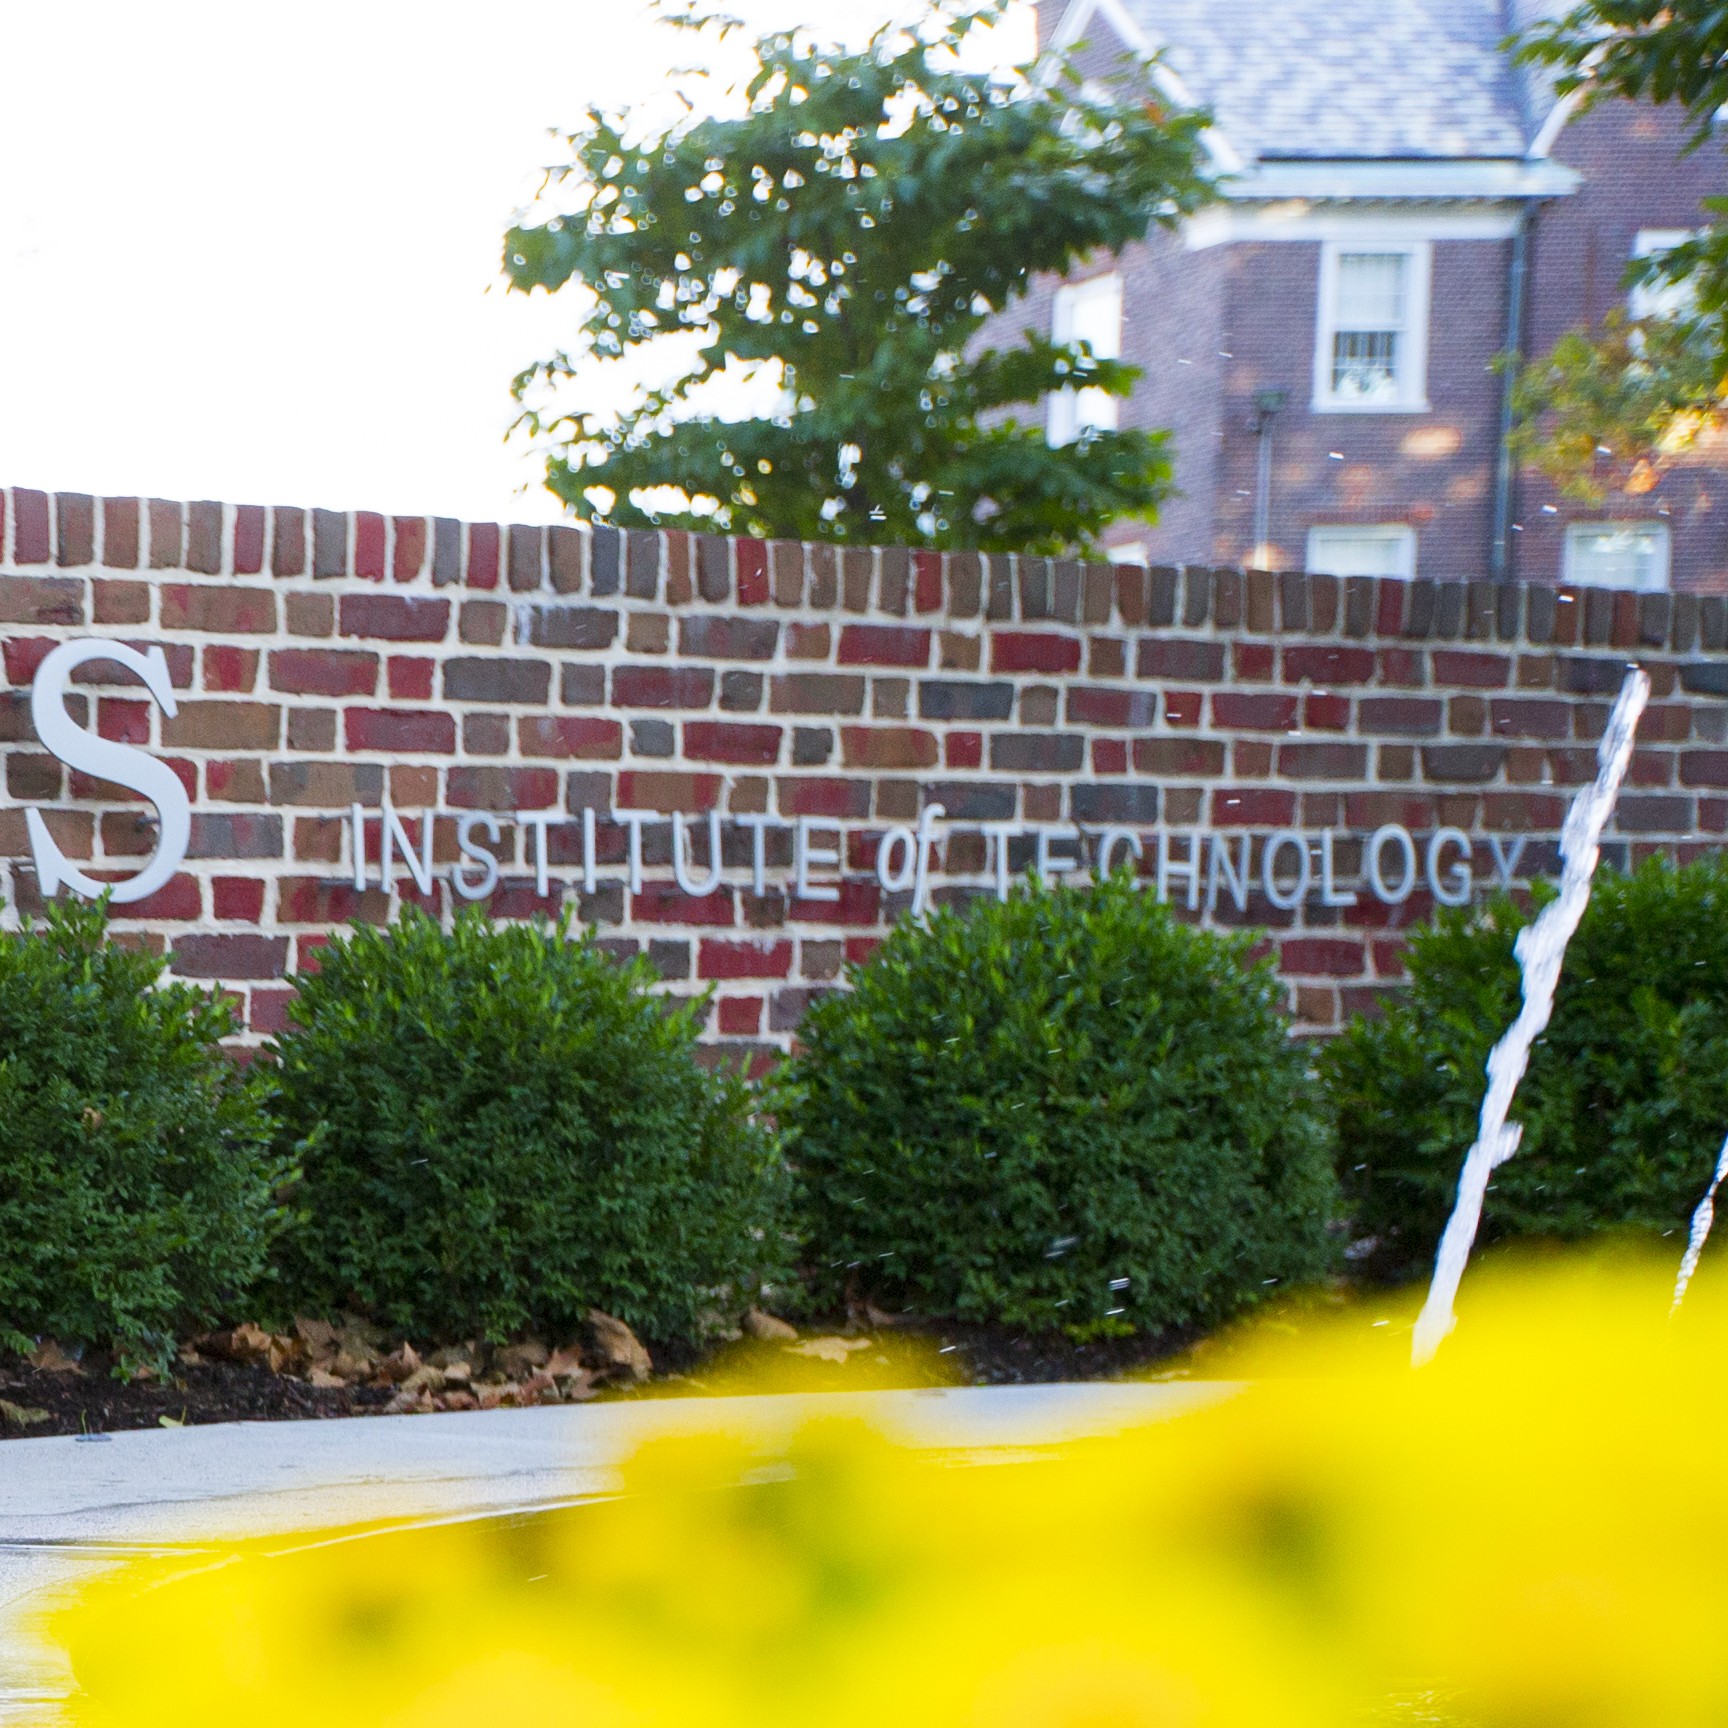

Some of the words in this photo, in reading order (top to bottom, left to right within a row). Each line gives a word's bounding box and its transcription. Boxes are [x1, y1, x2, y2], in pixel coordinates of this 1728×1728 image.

[351, 802, 840, 901] INSTITUTE
[878, 804, 946, 917] of
[982, 824, 1527, 911] TECHNOLOGY
